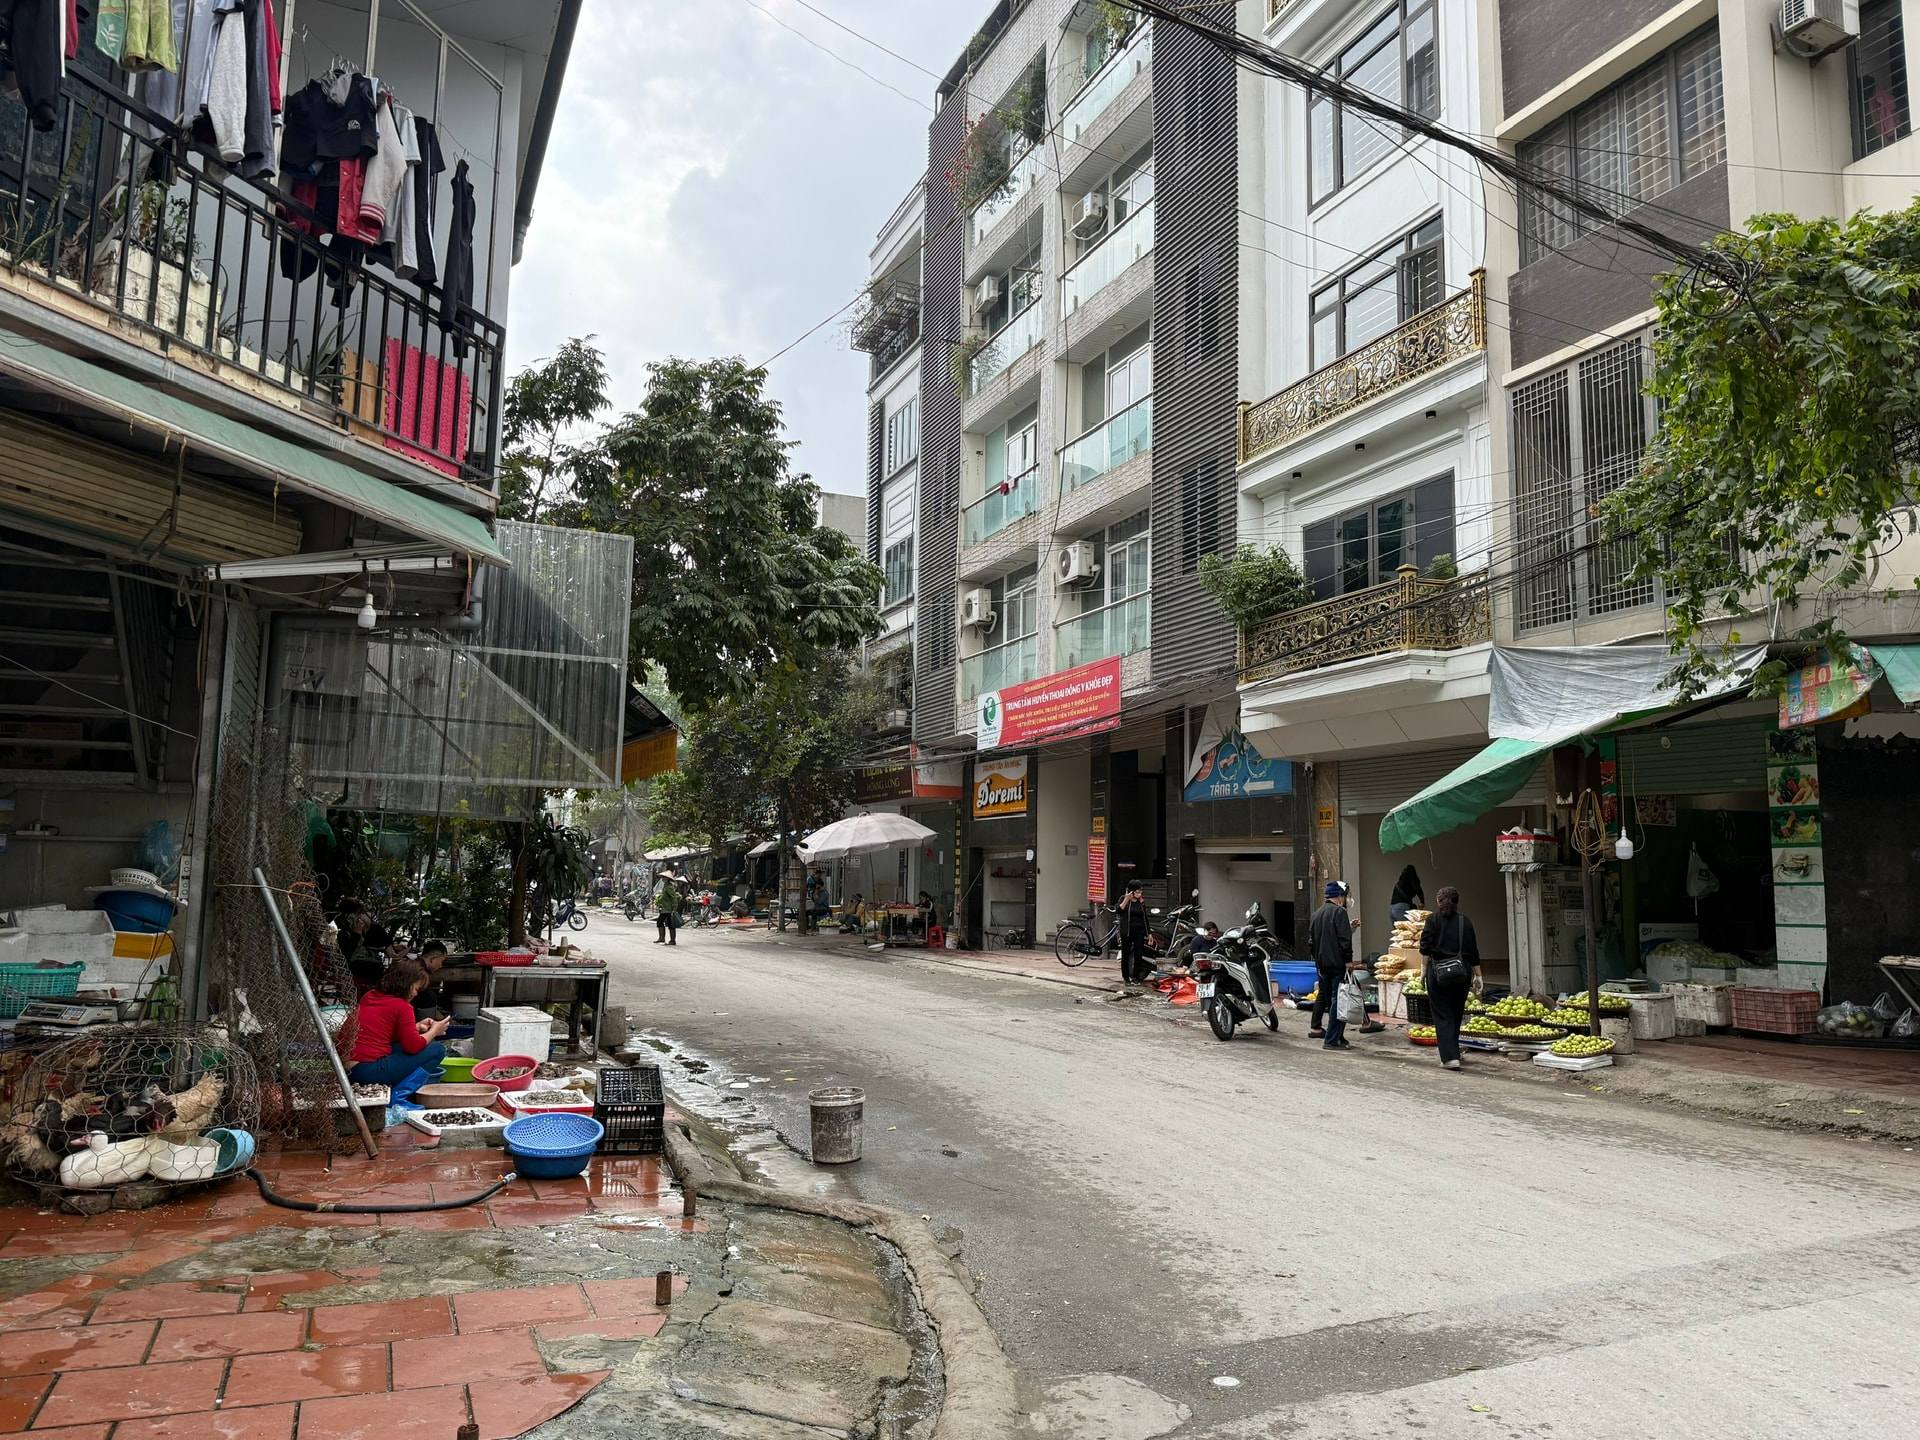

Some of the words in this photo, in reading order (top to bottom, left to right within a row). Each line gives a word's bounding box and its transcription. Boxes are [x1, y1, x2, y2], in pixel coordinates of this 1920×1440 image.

[1005, 699, 1021, 711] TRUNG
[976, 778, 1023, 808] Doremi
[1233, 783, 1239, 794] 2
